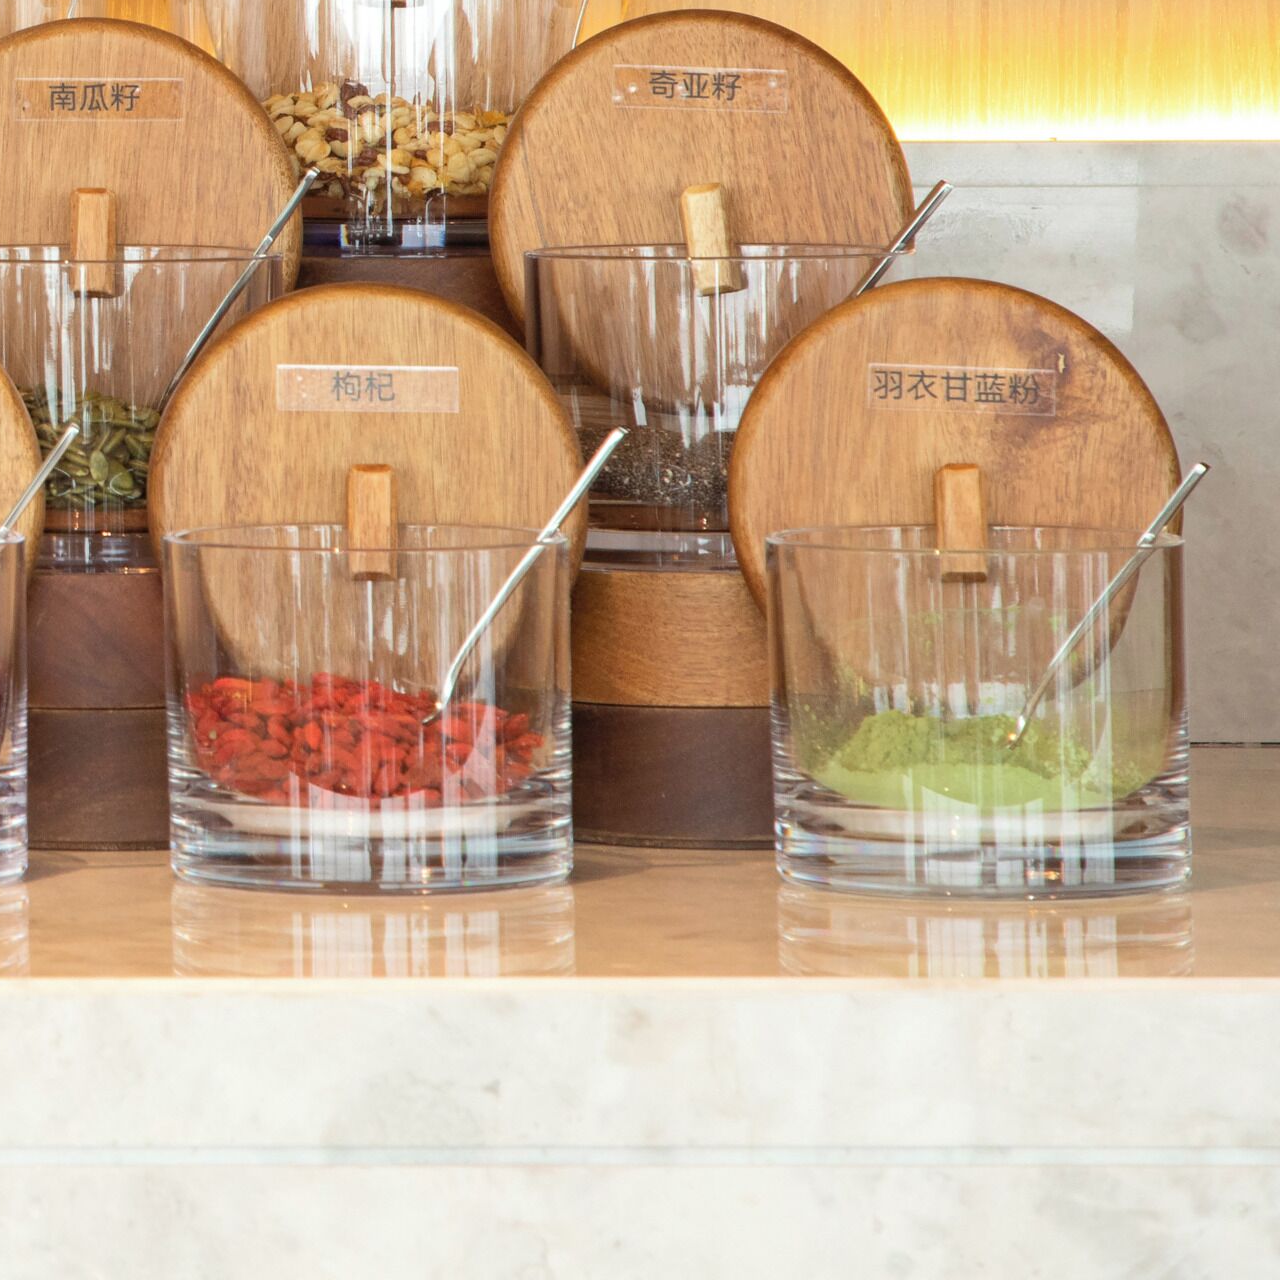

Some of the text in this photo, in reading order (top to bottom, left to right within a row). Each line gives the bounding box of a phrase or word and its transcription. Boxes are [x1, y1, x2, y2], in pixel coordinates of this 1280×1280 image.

[49, 82, 141, 113] 南瓜籽
[649, 70, 742, 101] 奇亚籽
[331, 370, 396, 402] 枸杞
[874, 369, 1041, 405] 羽衣甘蓝粉
